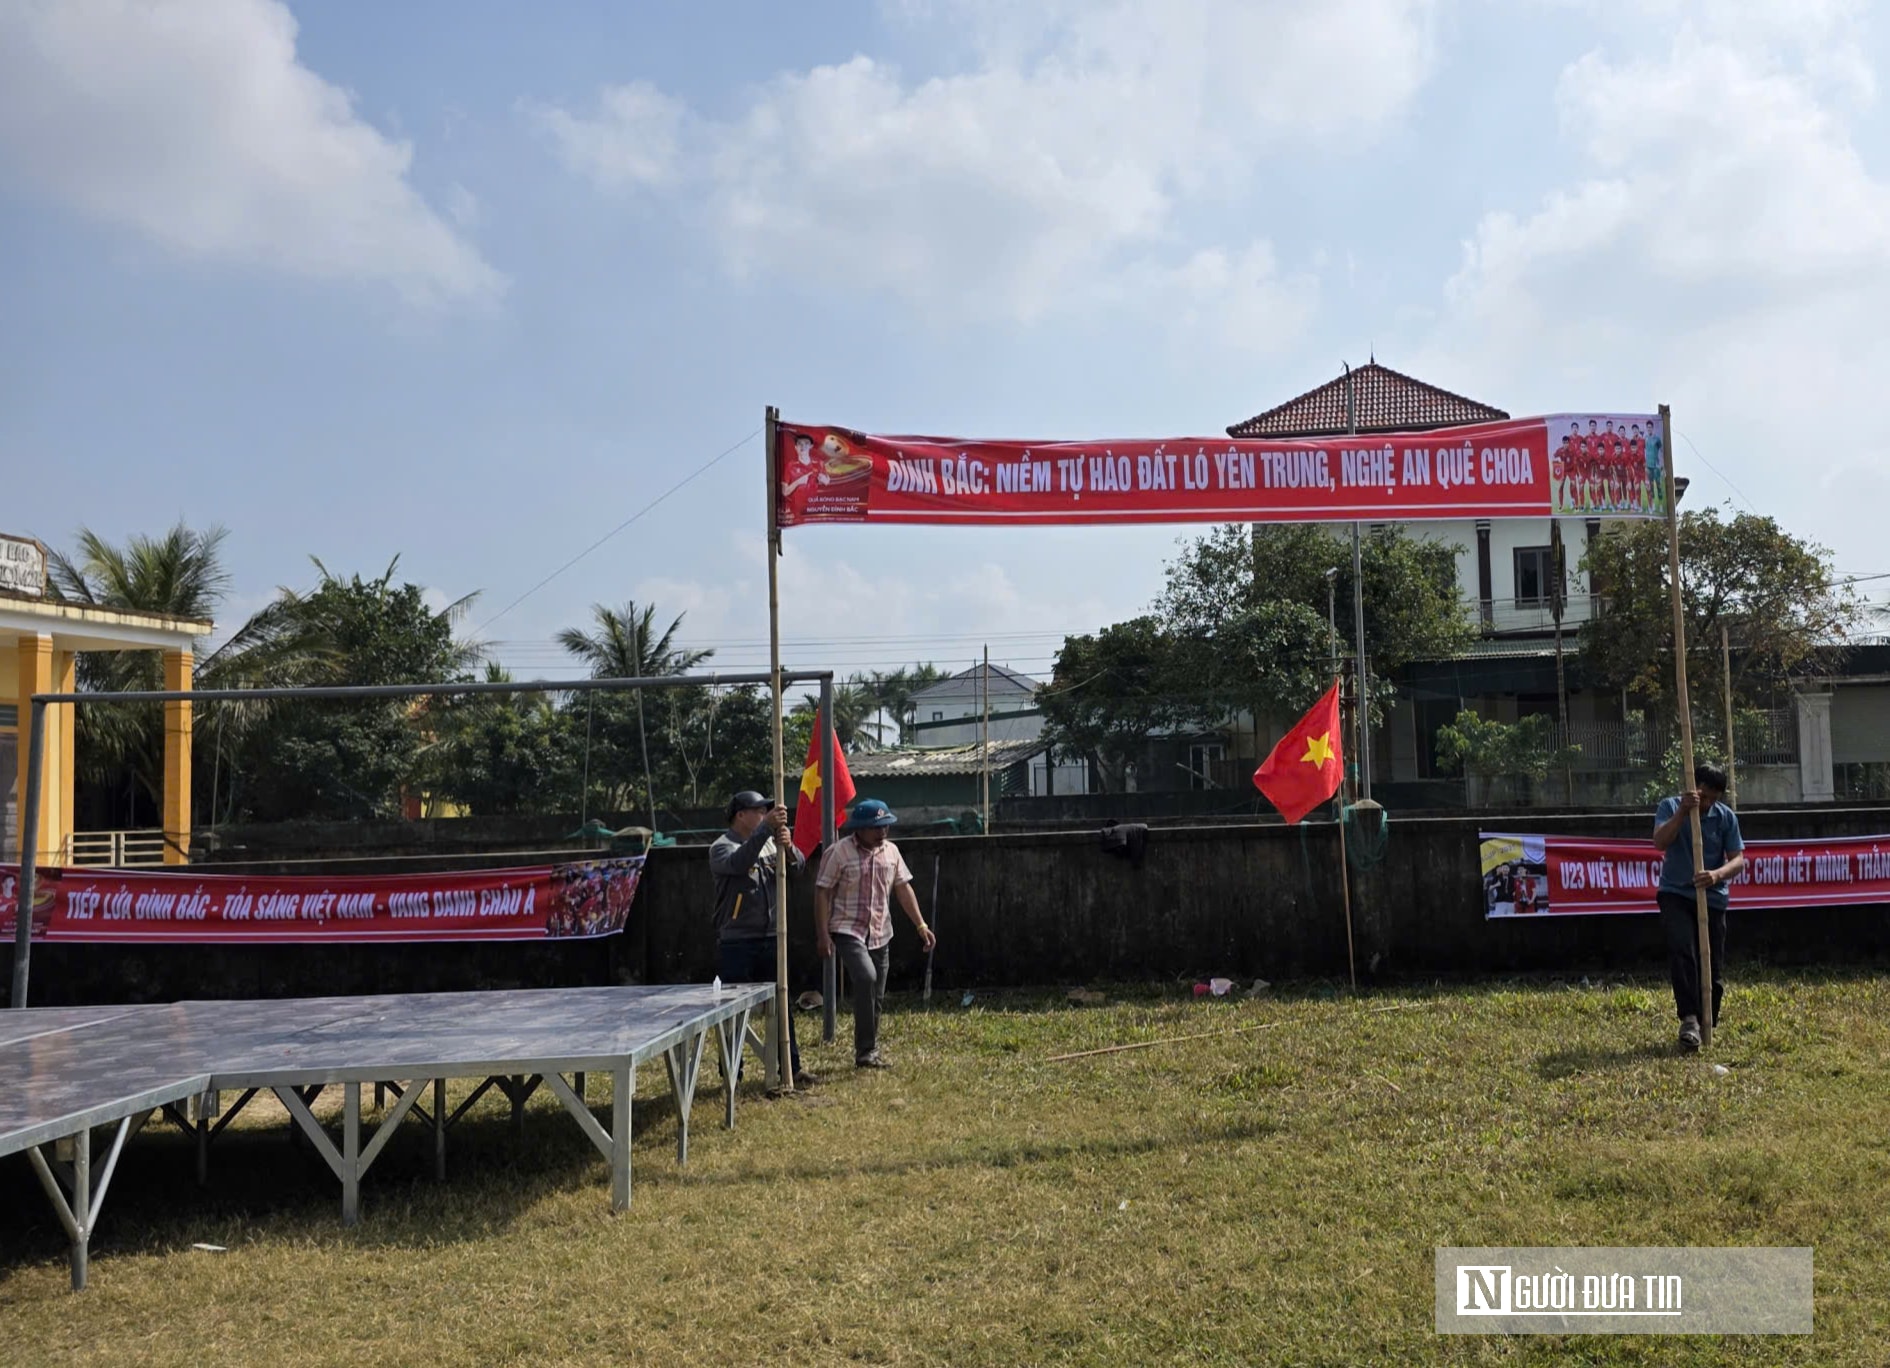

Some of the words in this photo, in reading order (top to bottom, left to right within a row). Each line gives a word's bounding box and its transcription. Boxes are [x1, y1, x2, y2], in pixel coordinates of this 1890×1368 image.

[887, 452, 938, 494] ĐÌNH
[941, 452, 990, 495] BẮC:
[996, 450, 1051, 493] NIỀM
[1058, 454, 1084, 500] TỰ
[1089, 450, 1132, 491] HÀO
[1138, 444, 1177, 490] ĐẤT
[1183, 447, 1208, 490] LÓ
[1214, 446, 1255, 489] YÊN
[1260, 450, 1335, 492] TRUNG,
[1341, 443, 1396, 495] NGHỆ
[1402, 449, 1430, 485] AN
[1436, 440, 1475, 490] QUÊ
[1481, 447, 1534, 485] CHOA
[1560, 861, 1585, 889] U23
[1587, 856, 1614, 894] VIỆT
[1617, 861, 1648, 888] NAM
[1754, 854, 1785, 884] CHƠI
[1788, 849, 1812, 882] HẾT
[1815, 850, 1853, 884] MÌNH,
[67, 884, 101, 919] TIẾP
[103, 884, 133, 919] LỬA
[135, 888, 176, 919] ĐÌNH
[175, 884, 210, 919] BẮC
[254, 889, 300, 919] SÁNG
[301, 889, 337, 925] VIỆT
[336, 893, 375, 918] NAM
[388, 892, 430, 918] VANG
[433, 890, 476, 917] DANH
[480, 883, 522, 915] CHÂU
